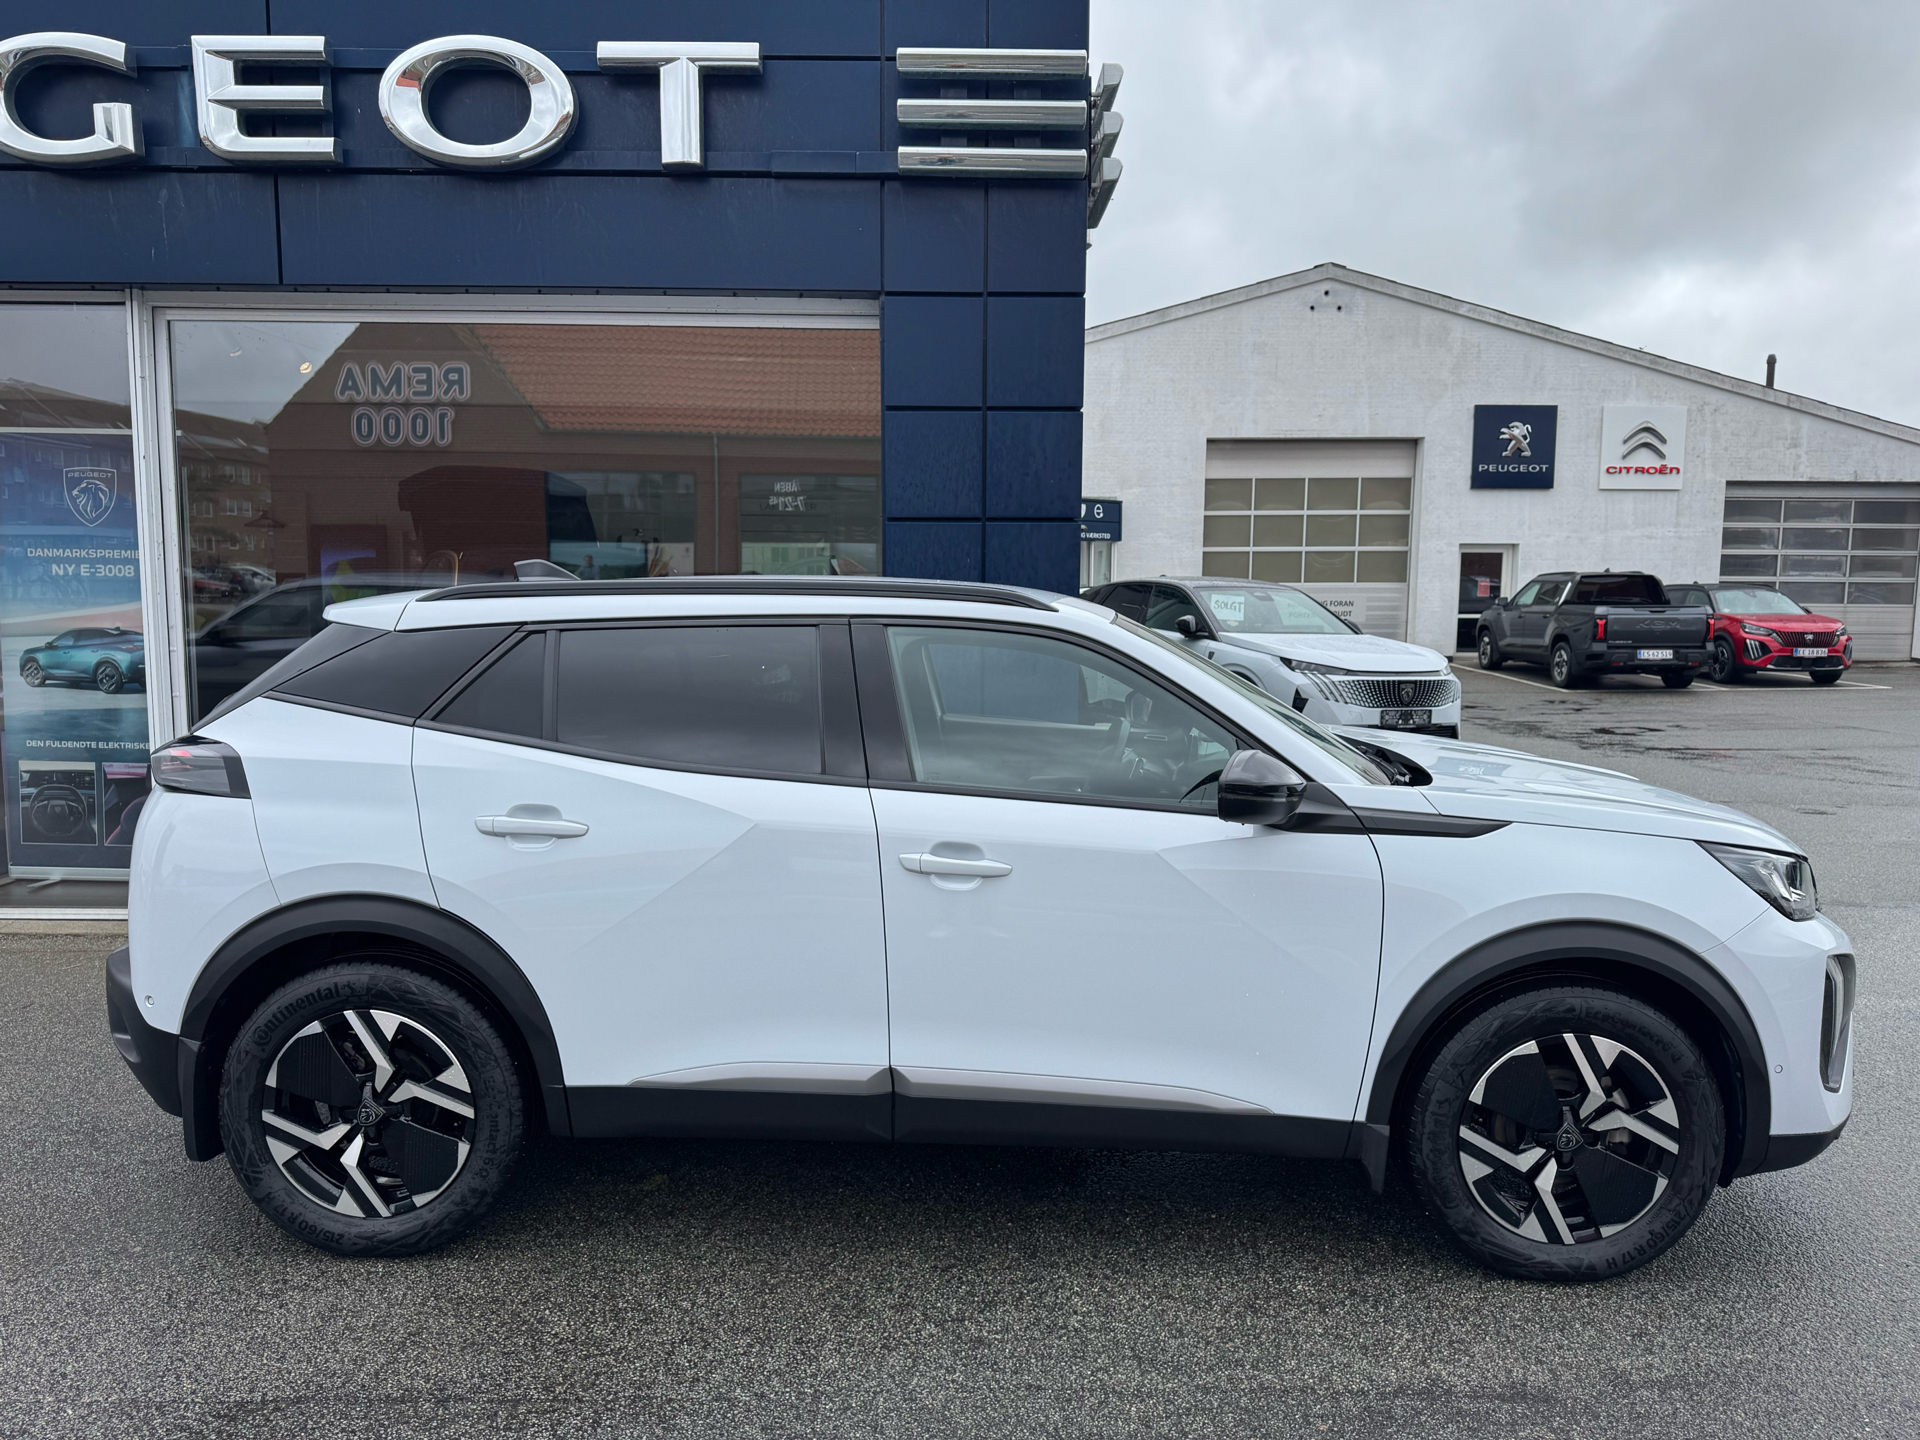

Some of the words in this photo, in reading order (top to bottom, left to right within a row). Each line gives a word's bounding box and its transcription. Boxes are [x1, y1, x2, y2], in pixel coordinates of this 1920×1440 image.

[0, 31, 763, 170] GEOT
[1478, 464, 1549, 473] PEUGEOT
[52, 563, 76, 576] NY
[80, 564, 135, 577] E-3008
[1213, 599, 1244, 613] SOLGT
[26, 740, 44, 748] DEN
[46, 740, 97, 749] FULDENDTE
[252, 982, 342, 1047] Continental
[287, 1211, 298, 1225] R
[298, 1219, 345, 1246] 215/60
[1646, 1211, 1687, 1250] 215/60
[1633, 1244, 1647, 1256] R
[1605, 1257, 1619, 1270] H
[1621, 1251, 1636, 1265] 17
